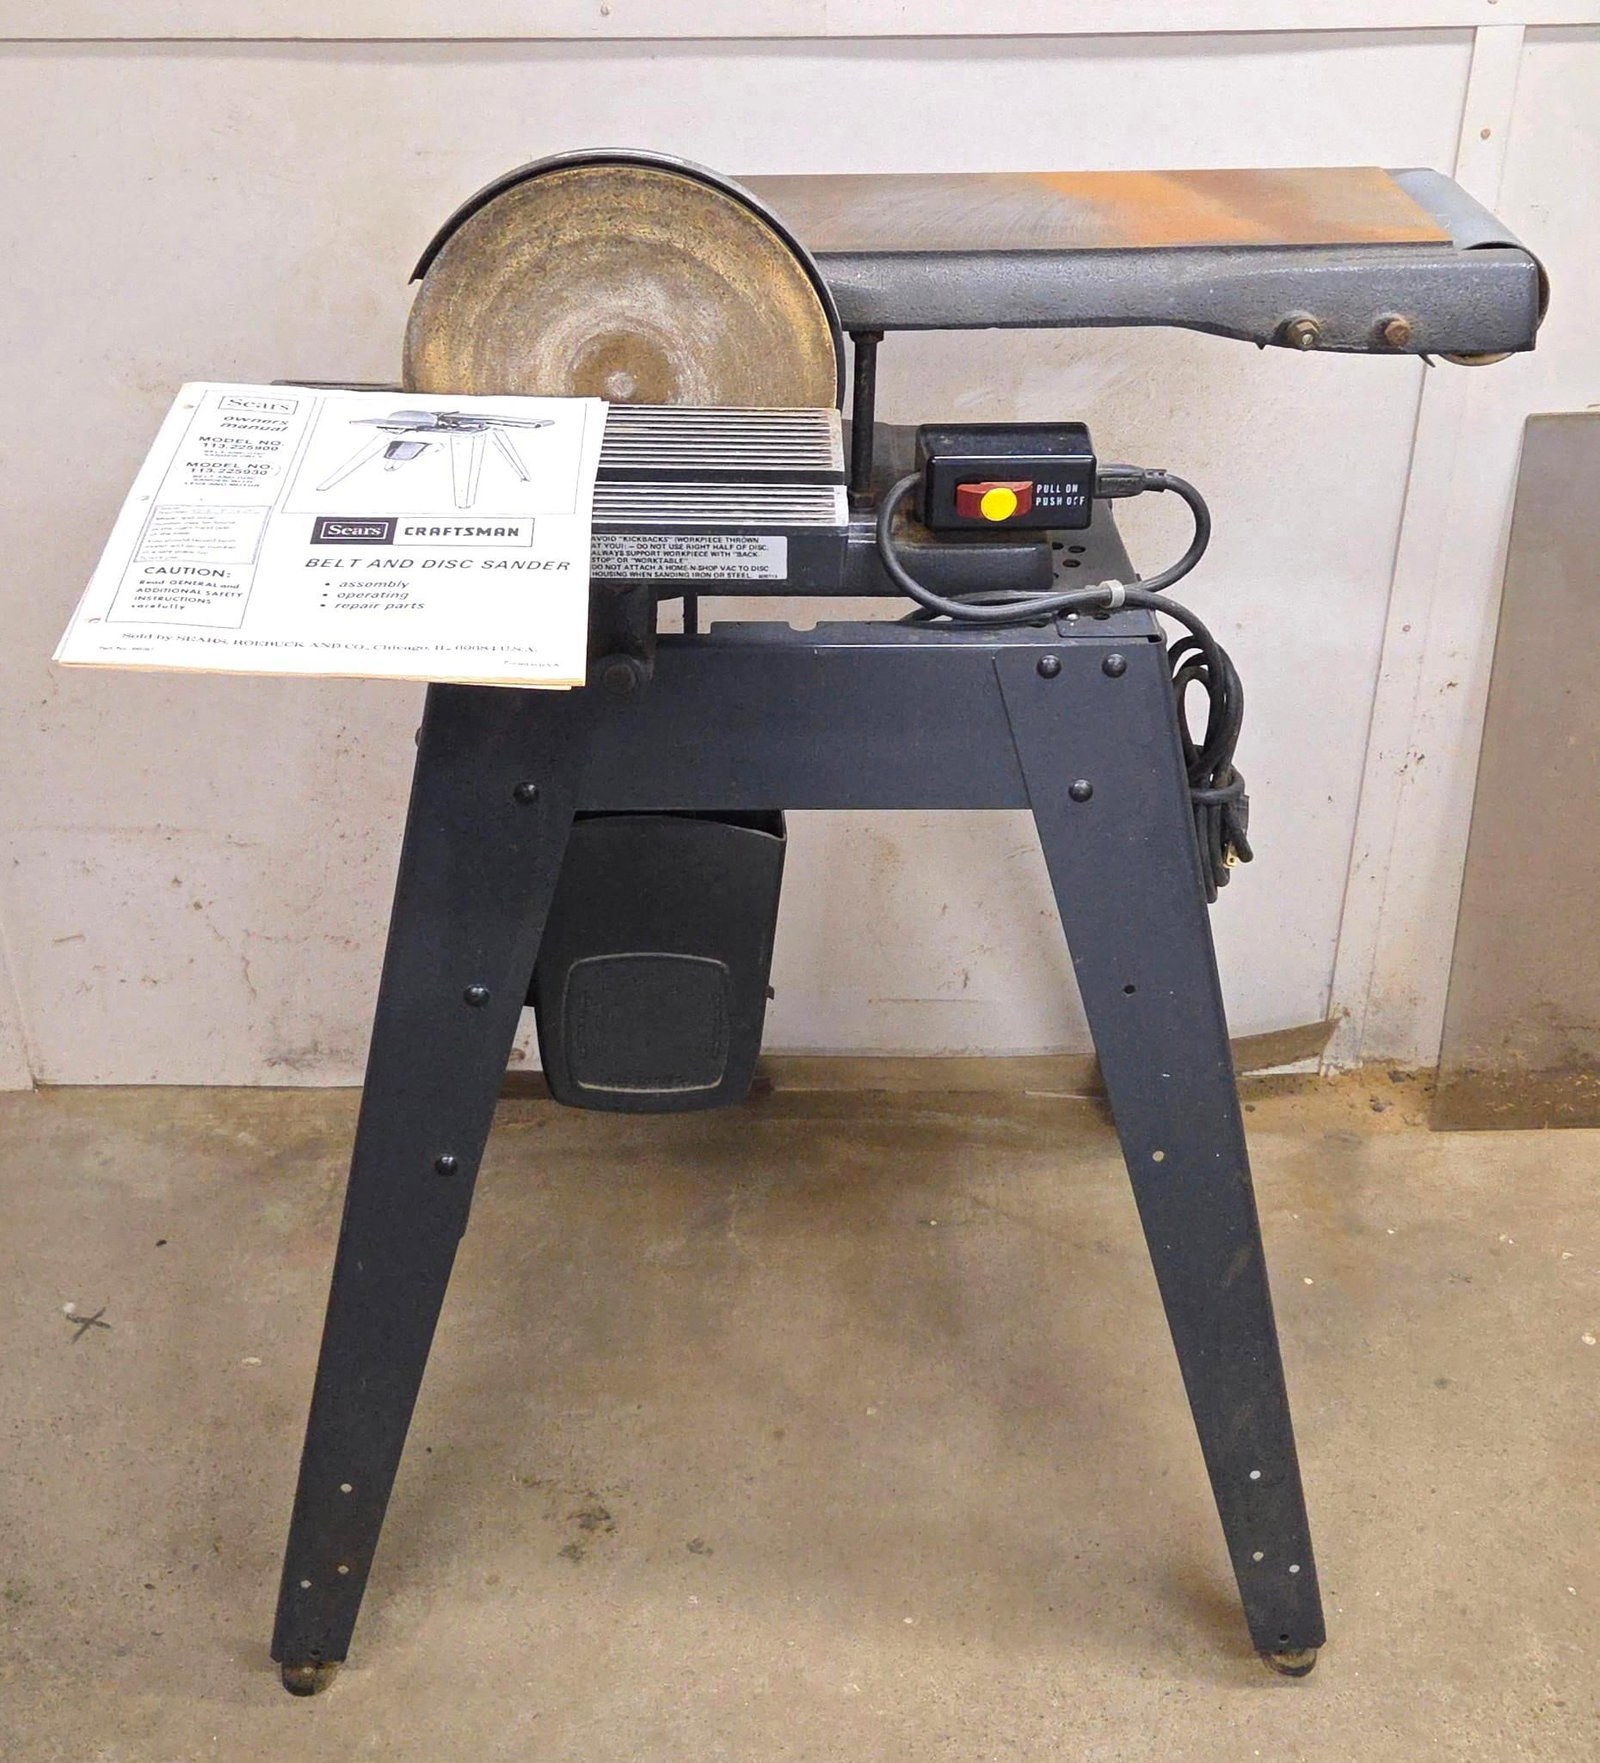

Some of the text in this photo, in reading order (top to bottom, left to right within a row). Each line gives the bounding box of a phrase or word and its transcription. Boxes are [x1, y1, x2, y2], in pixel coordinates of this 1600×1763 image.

[227, 399, 289, 410] Sears
[220, 423, 288, 432] manual
[199, 436, 252, 444] MODEL
[1036, 484, 1079, 493] PULL ON
[1035, 497, 1062, 506] PUSH
[327, 524, 381, 537] Sears
[404, 527, 519, 537] CRAFTSMAN
[305, 558, 571, 571] BELT AND DISC SANDER
[144, 567, 231, 578] CAUTION:
[169, 580, 217, 588] GENERAL
[339, 580, 410, 589] assembly
[134, 596, 212, 604] INSTRUCTIONS
[337, 591, 410, 600] operating
[334, 602, 426, 611] repair parts
[122, 632, 153, 640] Sold
